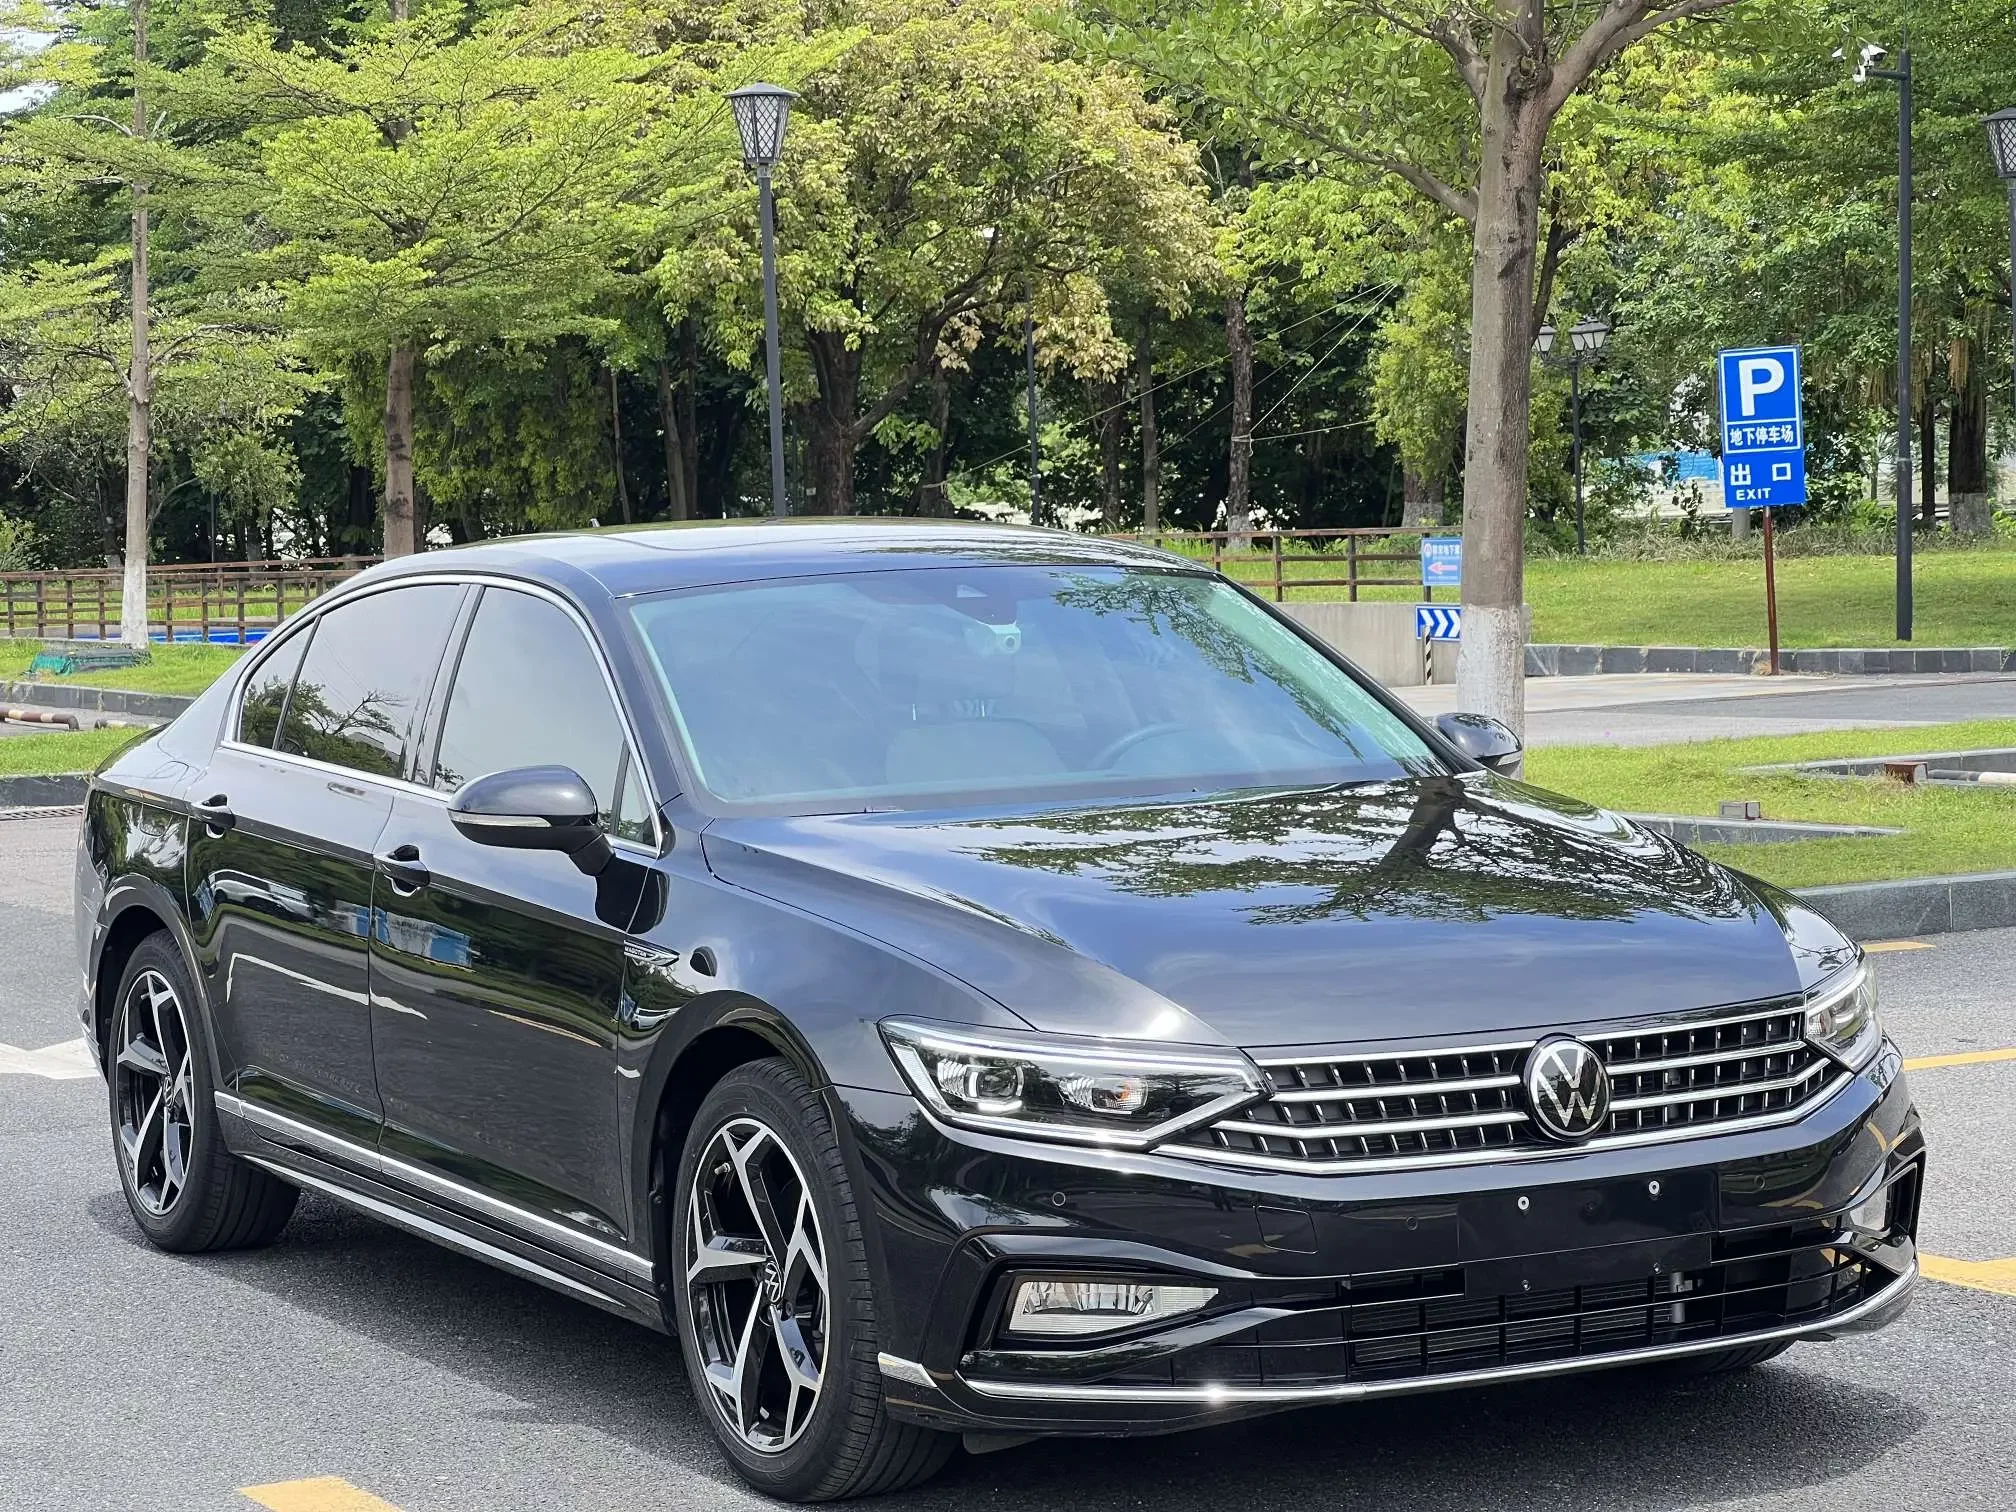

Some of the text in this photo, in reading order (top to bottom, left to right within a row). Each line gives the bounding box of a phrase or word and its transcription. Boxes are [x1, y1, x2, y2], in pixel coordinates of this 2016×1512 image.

[1738, 357, 1785, 417] P
[1730, 424, 1794, 447] 地下停车场
[1736, 487, 1772, 501] EXIT
[1533, 1044, 1605, 1130] VW
